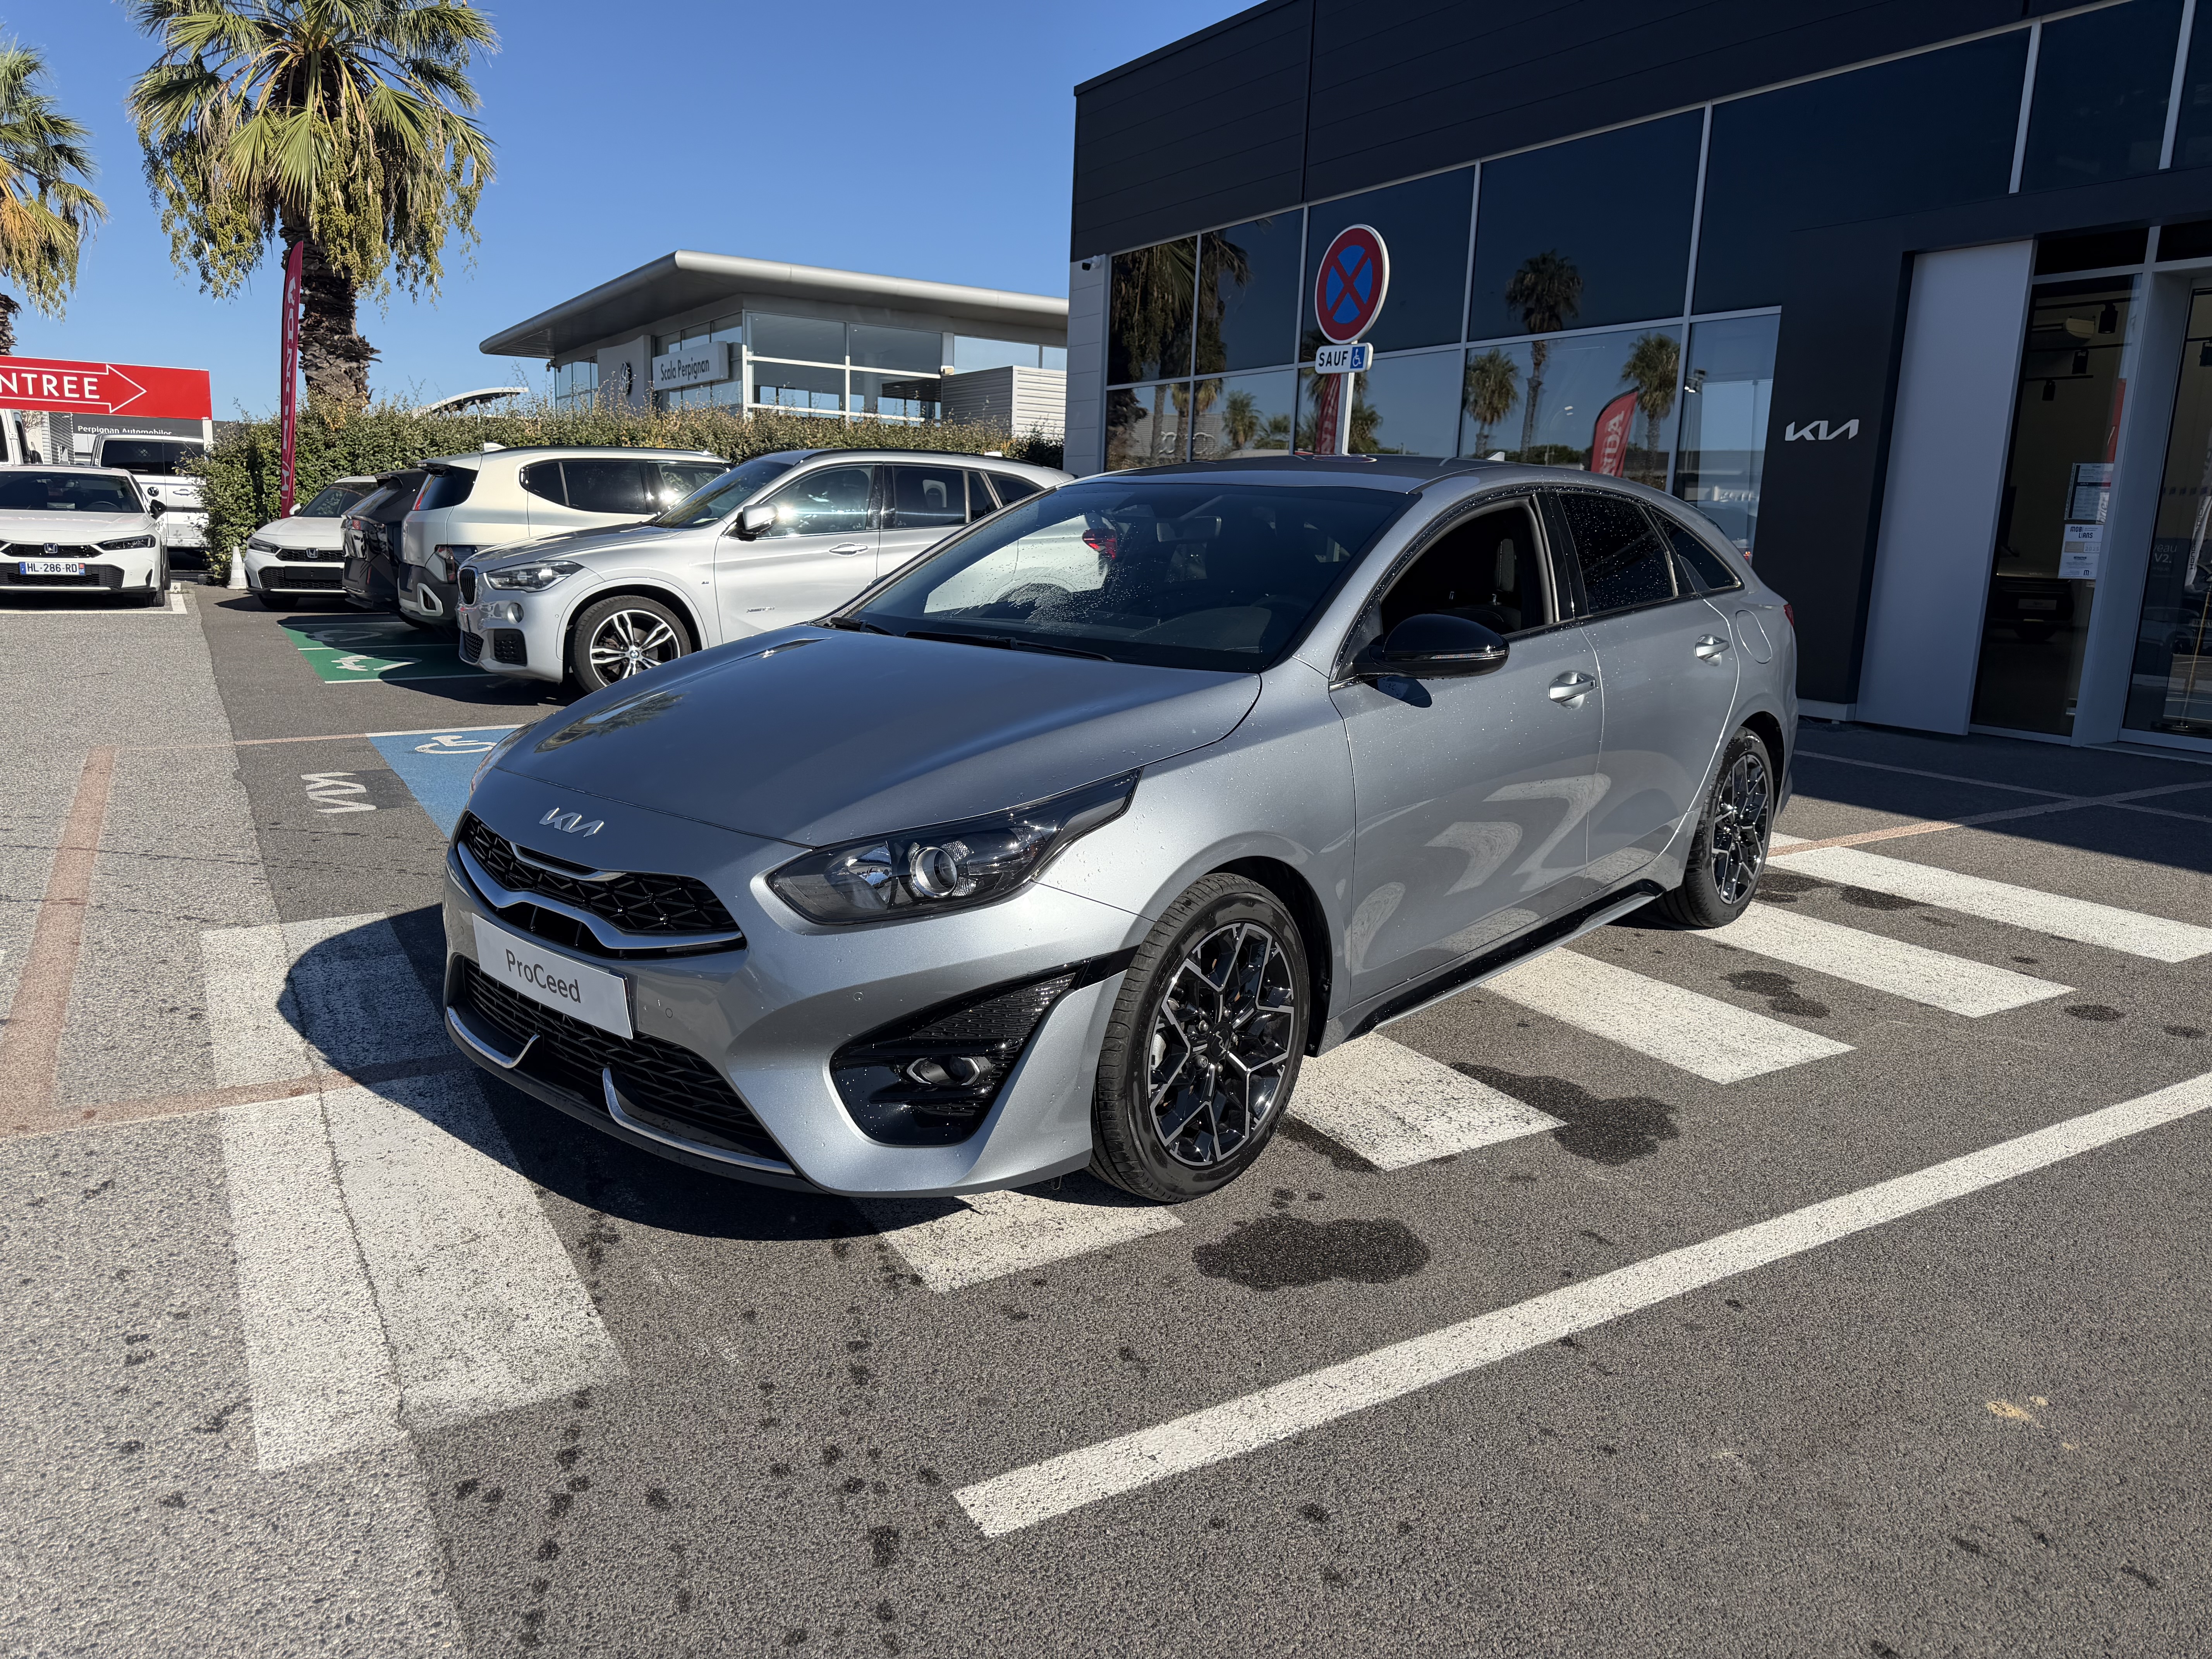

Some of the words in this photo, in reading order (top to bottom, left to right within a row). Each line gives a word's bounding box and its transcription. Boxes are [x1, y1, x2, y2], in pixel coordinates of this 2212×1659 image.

[283, 276, 296, 451] HONDA
[660, 360, 677, 381] Scala
[678, 356, 710, 381] Perpignan
[1319, 350, 1348, 367] SAUF
[78, 425, 120, 434] Perpignan
[1784, 419, 1859, 441] KIA
[27, 563, 77, 573] HL-286-RD
[301, 771, 377, 814] KIA
[539, 807, 605, 838] KIA
[505, 949, 582, 1004] ProCeed
